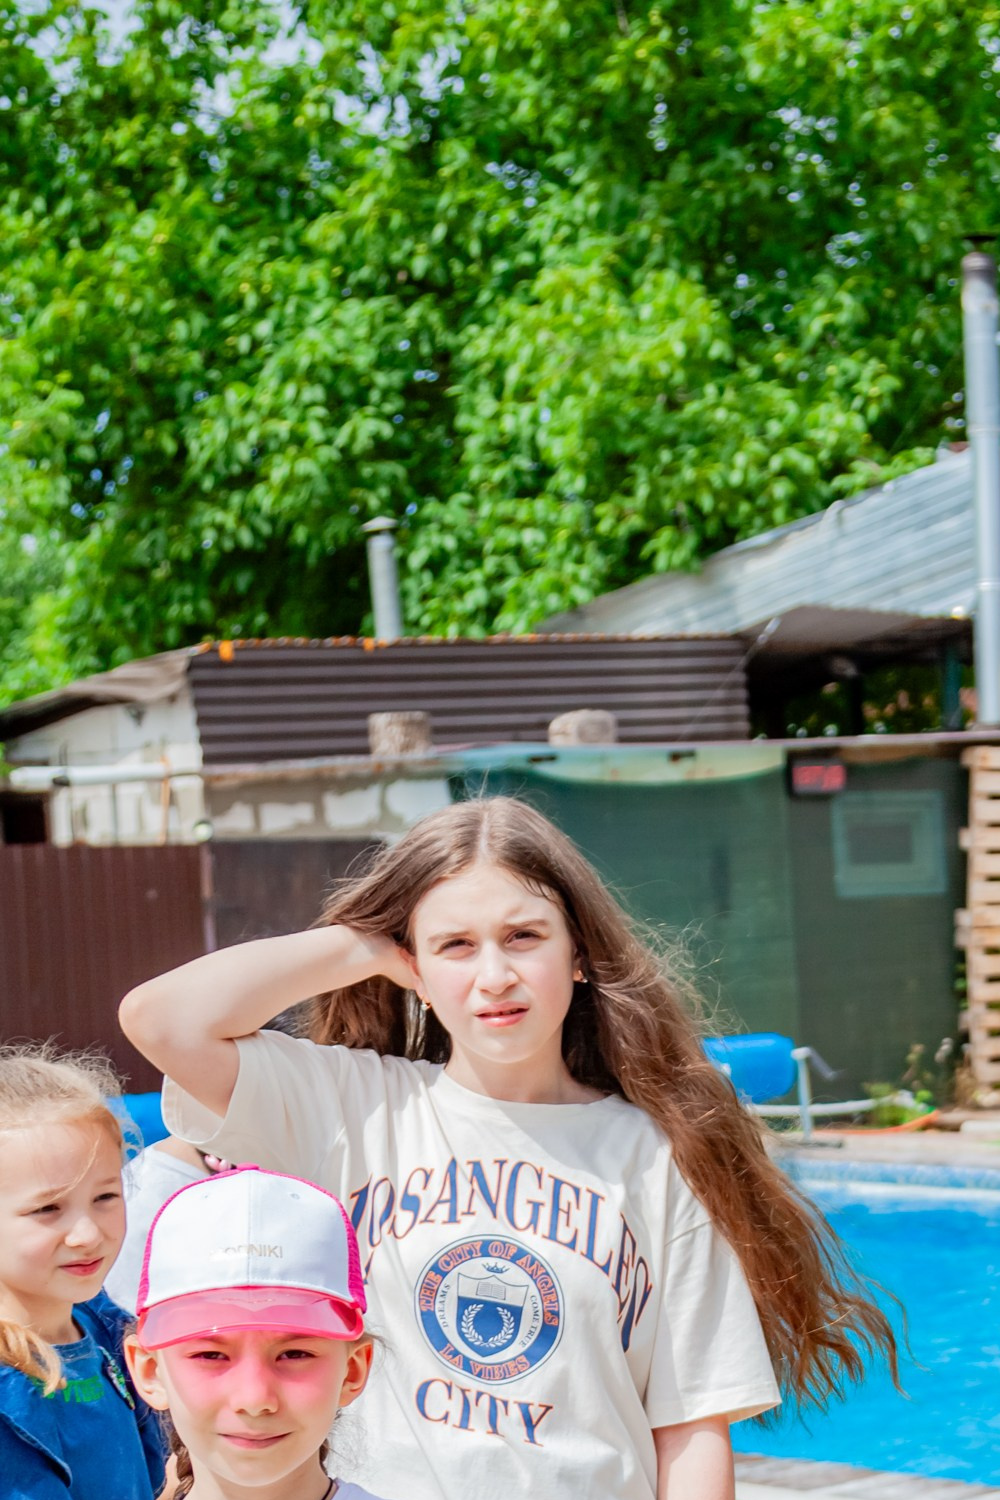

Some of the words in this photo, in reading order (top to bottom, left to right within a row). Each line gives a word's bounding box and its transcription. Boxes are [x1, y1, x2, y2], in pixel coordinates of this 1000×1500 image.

[419, 1271, 443, 1311] THE
[438, 1241, 483, 1271] CITY
[488, 1241, 517, 1259] OF
[438, 1282, 450, 1328] DREAMS
[439, 1342, 463, 1369] LA
[469, 1354, 530, 1380] VIBES
[415, 1379, 553, 1447] CITY
